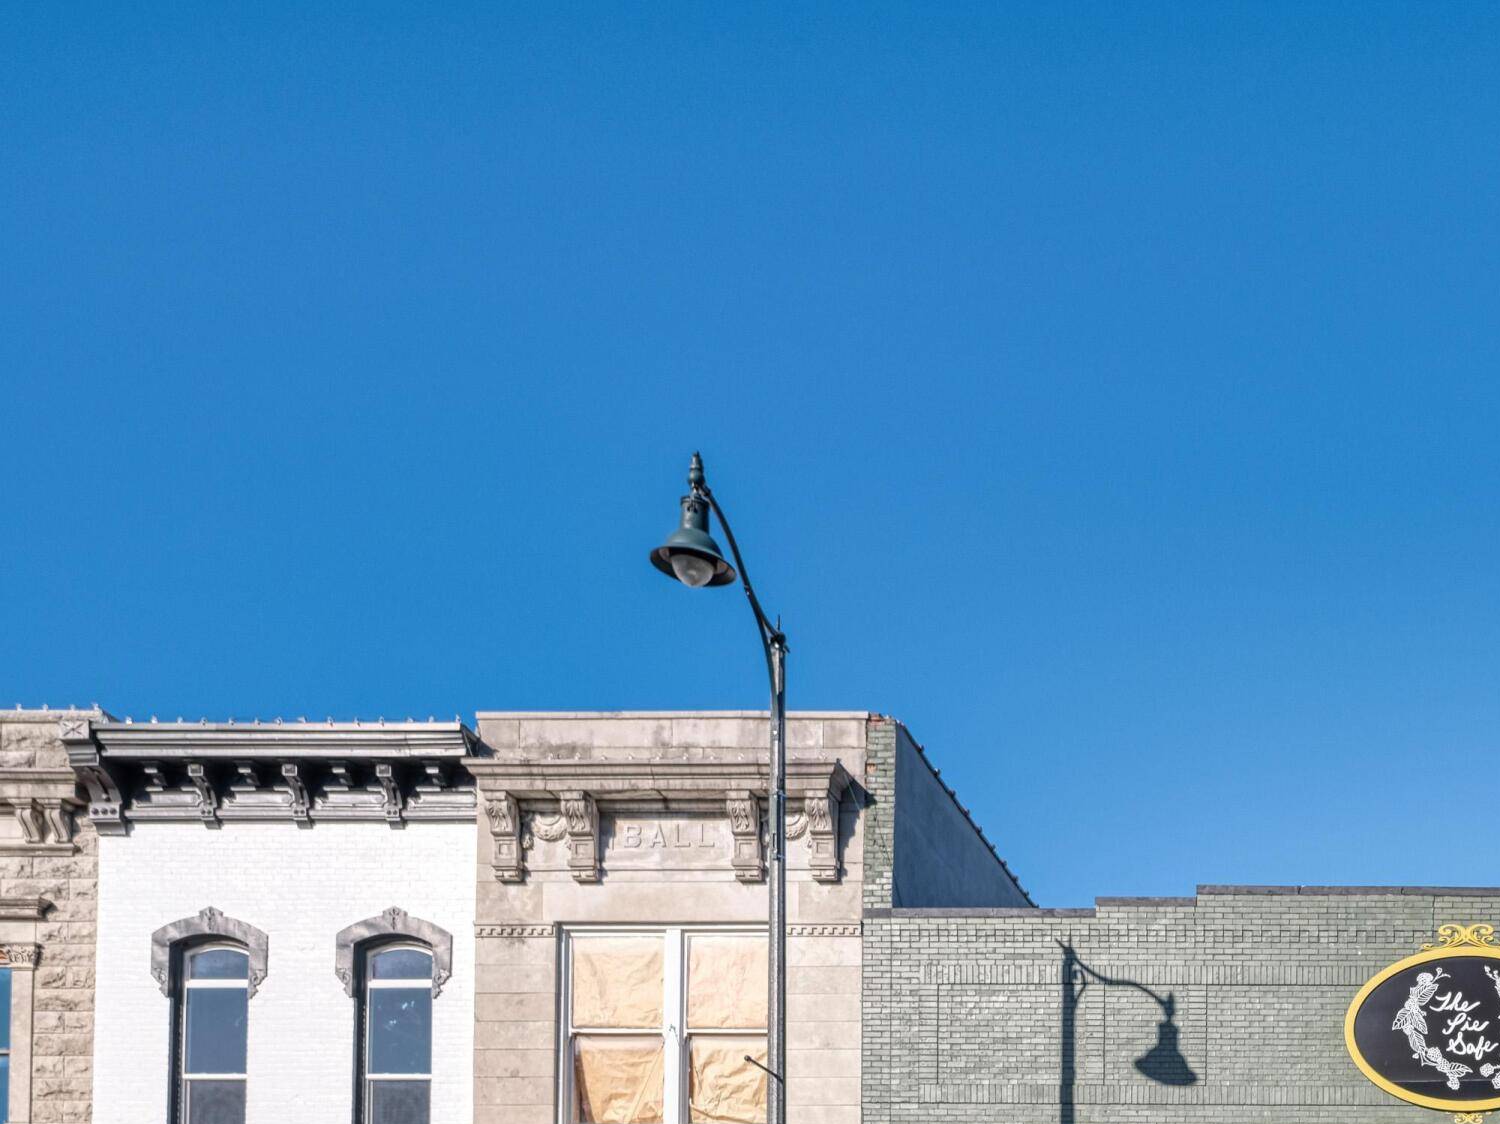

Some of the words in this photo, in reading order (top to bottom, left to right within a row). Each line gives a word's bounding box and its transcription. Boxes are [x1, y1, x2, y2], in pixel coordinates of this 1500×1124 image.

[623, 823, 716, 849] BALL
[1429, 991, 1481, 1012] The
[1442, 1012, 1490, 1035] Pie
[1446, 1031, 1499, 1060] Safe
